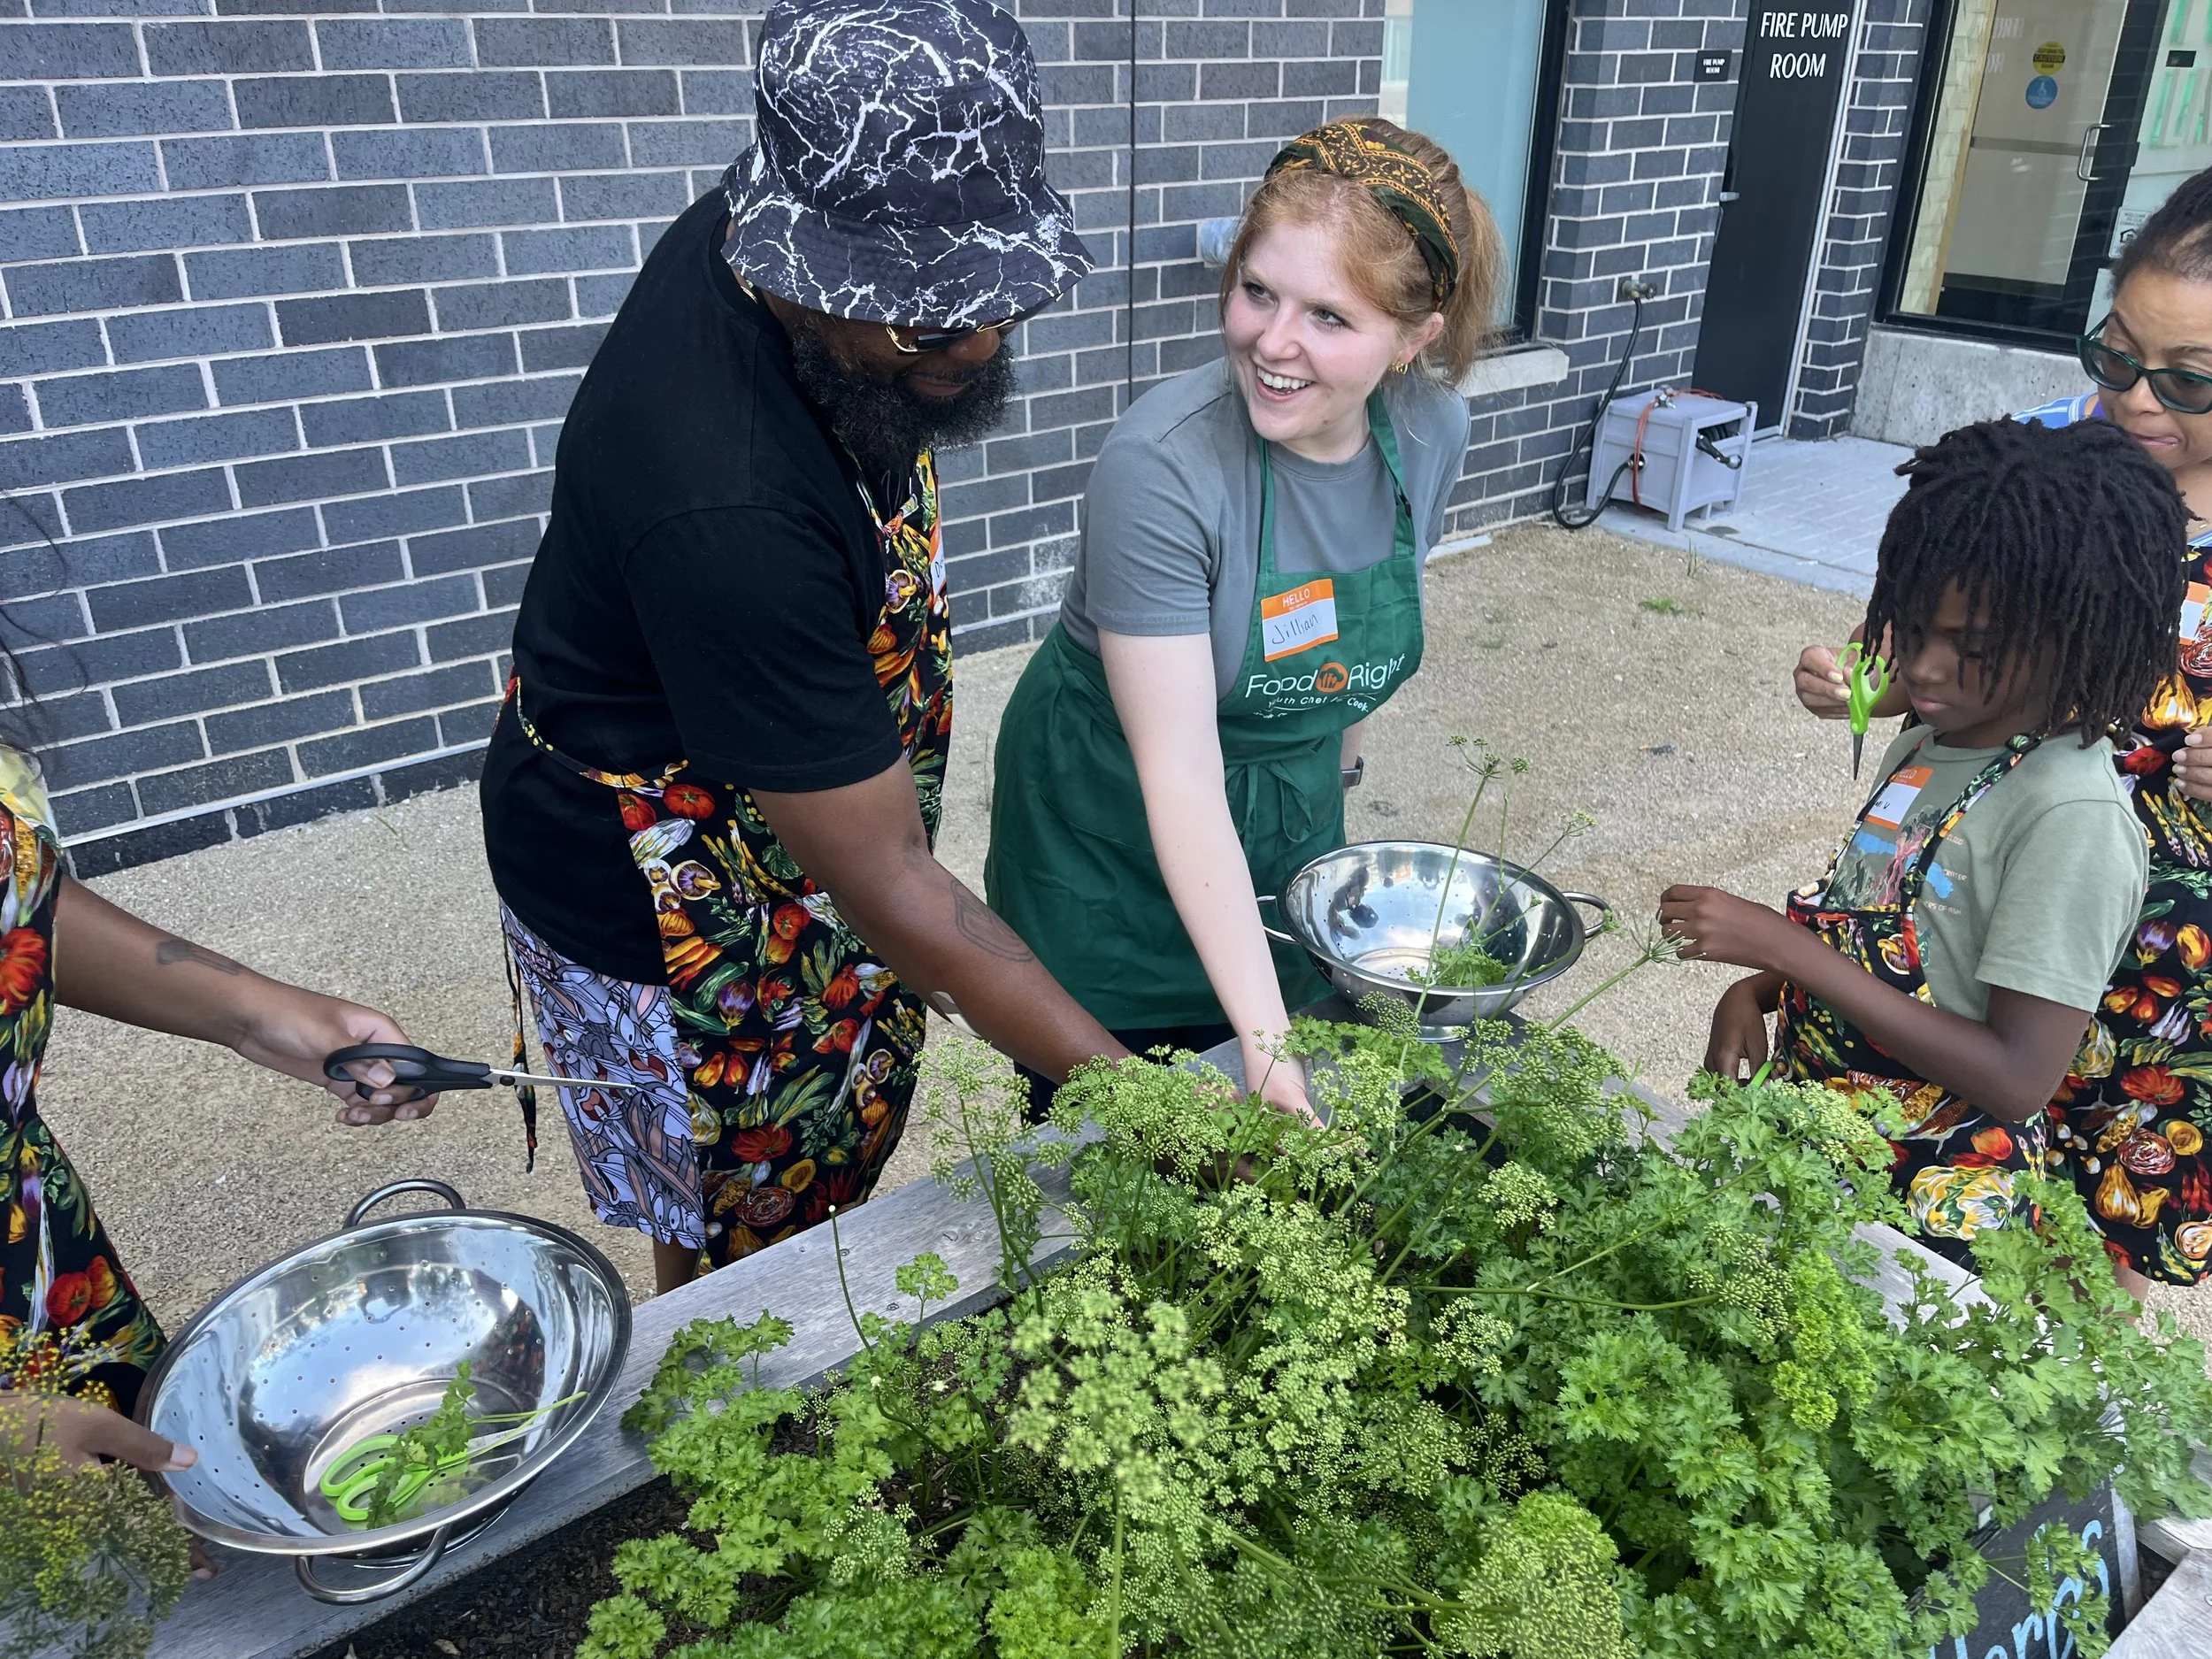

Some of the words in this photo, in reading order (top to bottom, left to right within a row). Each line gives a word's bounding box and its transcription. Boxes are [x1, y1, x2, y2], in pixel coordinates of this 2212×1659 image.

[1761, 12, 1799, 38] FIRE
[1801, 12, 1848, 38] PUMP
[1770, 52, 1826, 79] ROOM
[1282, 588, 1310, 608] HELLO
[1271, 613, 1319, 645] Jillian
[1245, 669, 1319, 698] Food
[1347, 653, 1405, 690] Right
